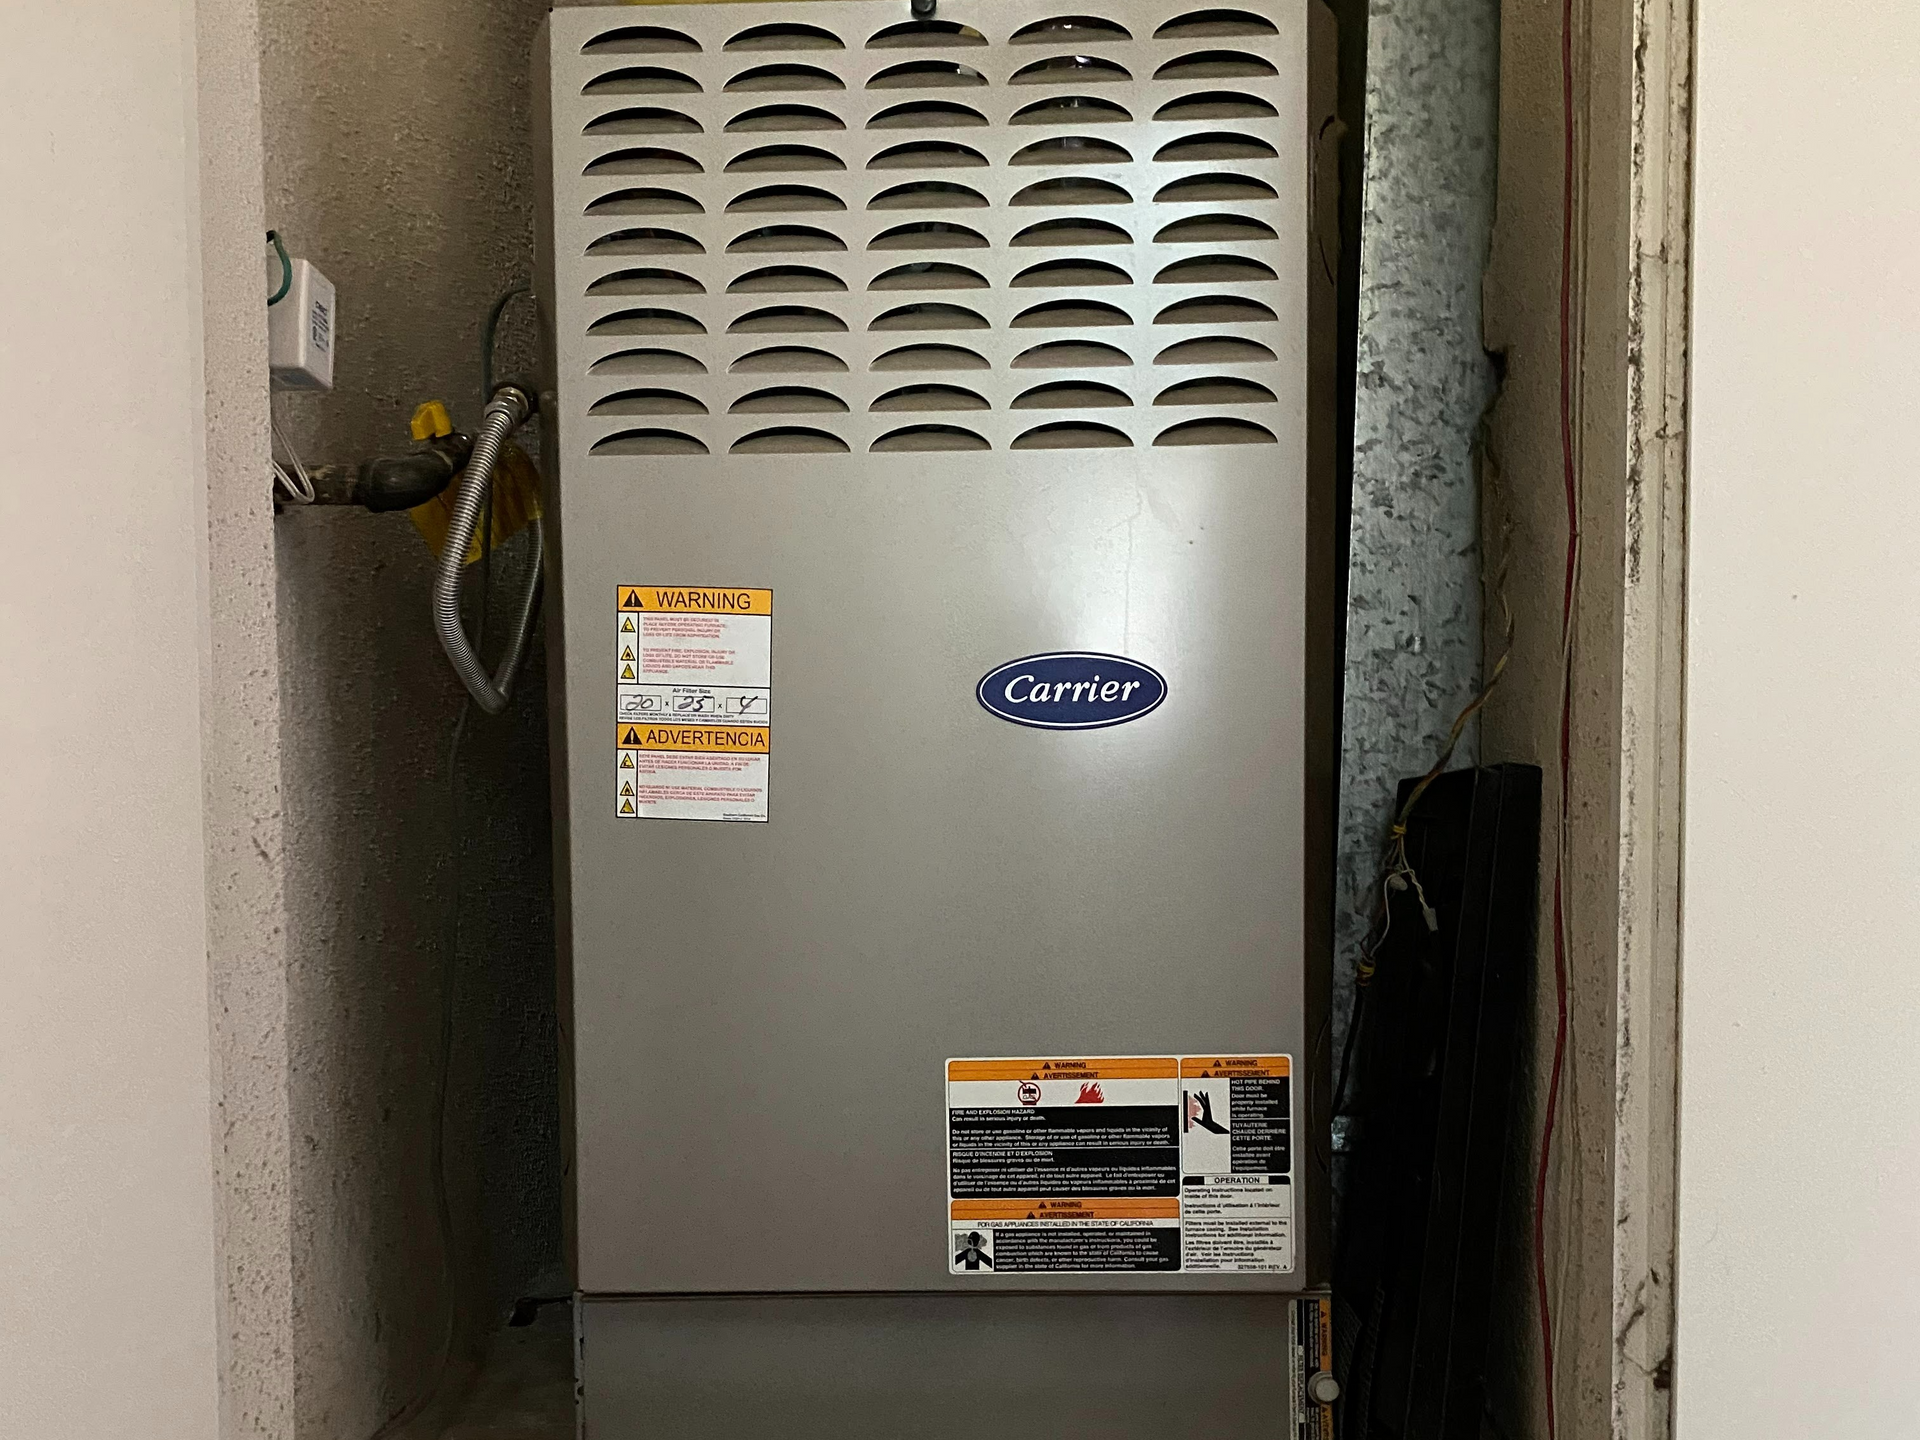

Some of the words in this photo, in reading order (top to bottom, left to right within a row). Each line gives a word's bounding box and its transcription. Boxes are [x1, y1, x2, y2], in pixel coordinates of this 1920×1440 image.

[656, 591, 751, 609] WARNING
[1005, 675, 1140, 703] Carrier
[626, 694, 653, 710] 20
[678, 696, 714, 712] 25
[739, 696, 758, 715] 4
[646, 730, 765, 746] ADVERTENCIA
